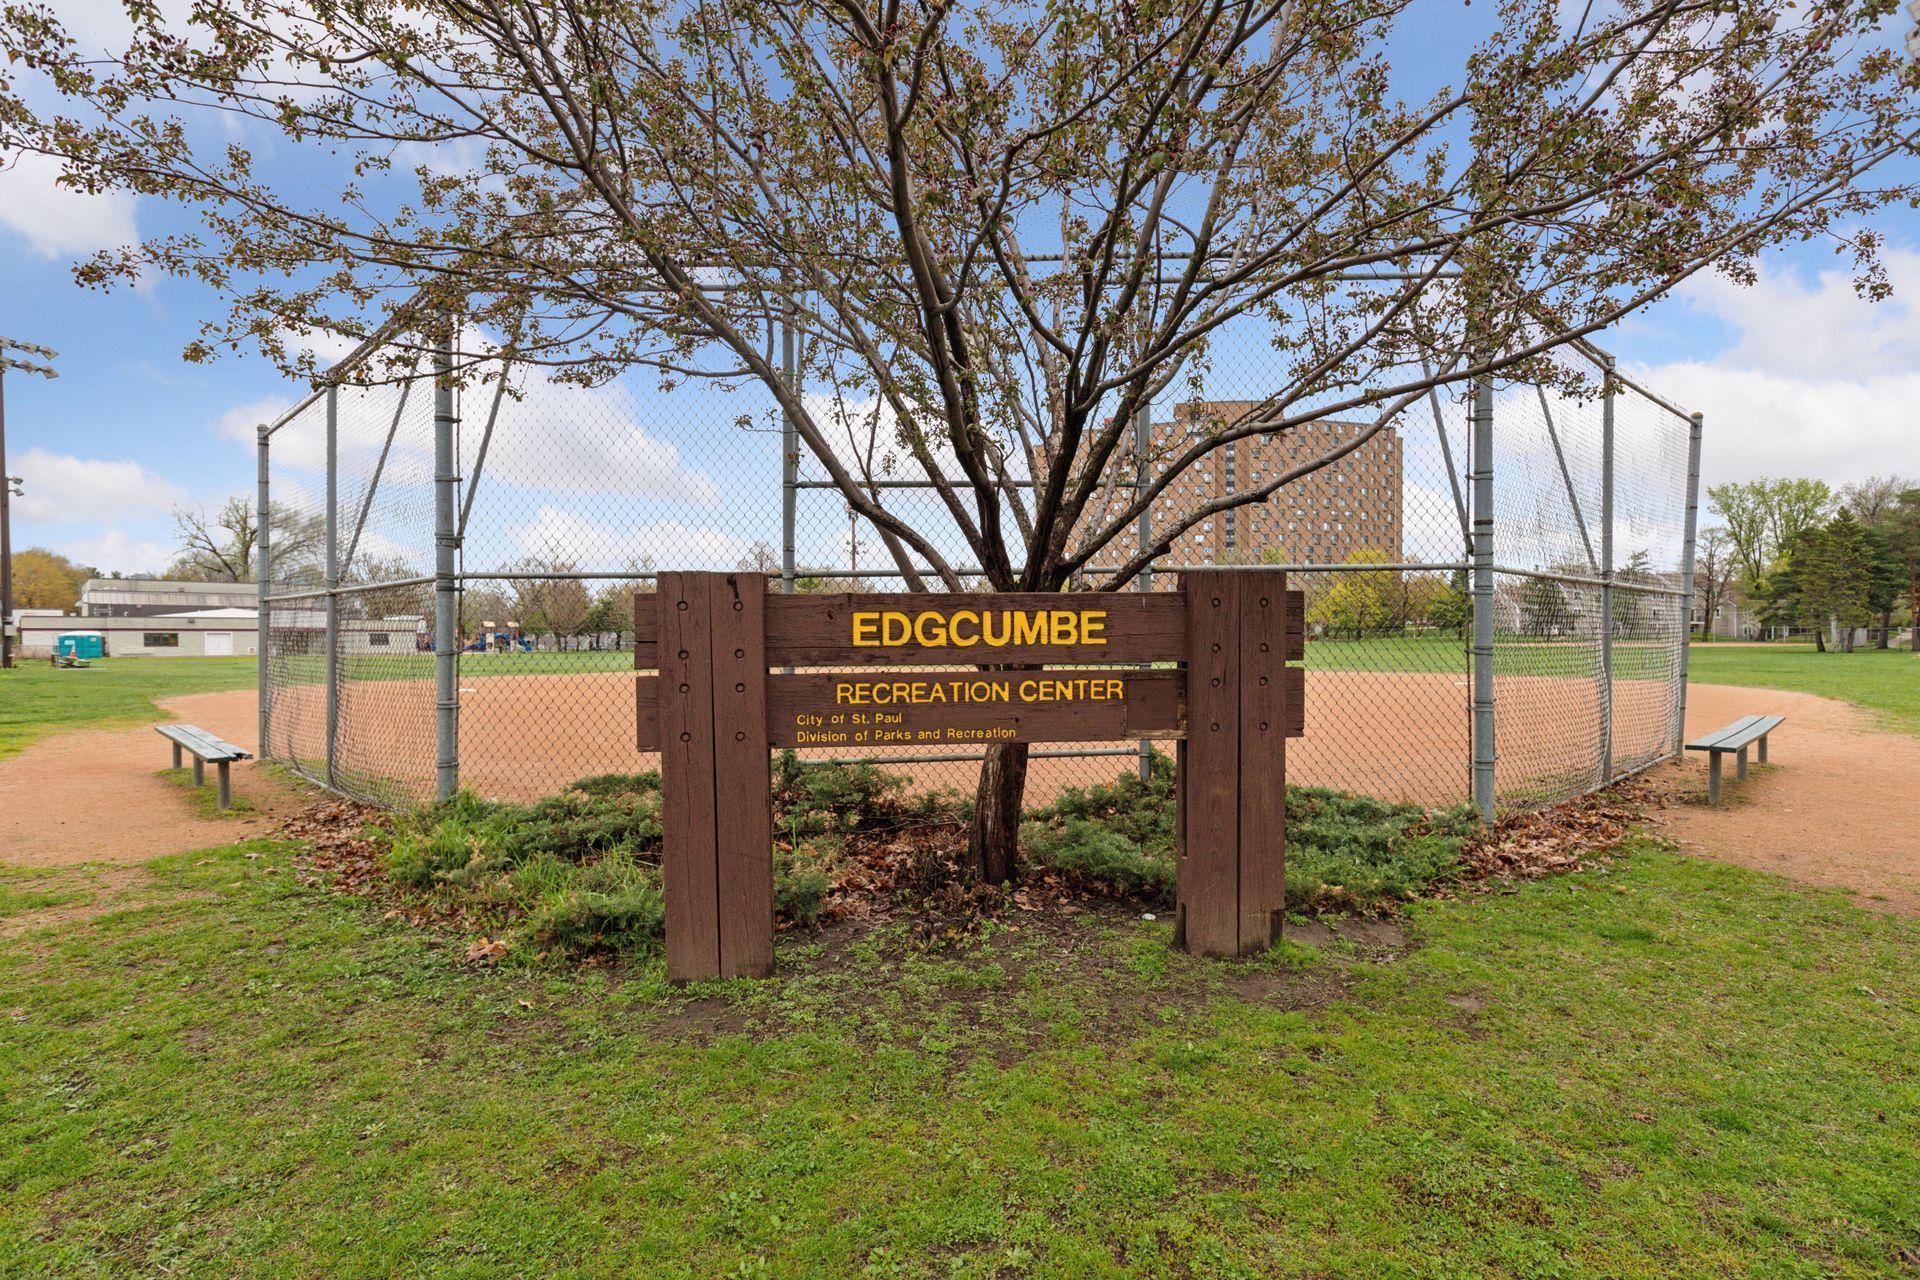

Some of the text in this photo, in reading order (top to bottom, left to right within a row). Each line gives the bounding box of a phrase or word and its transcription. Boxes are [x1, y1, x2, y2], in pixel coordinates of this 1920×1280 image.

[852, 610, 1107, 647] EDGCUMBE
[836, 679, 1124, 704] RECREATION CENTER
[796, 712, 902, 727] City of St. Paul
[797, 726, 1017, 743] Division of Parks and Recreation
